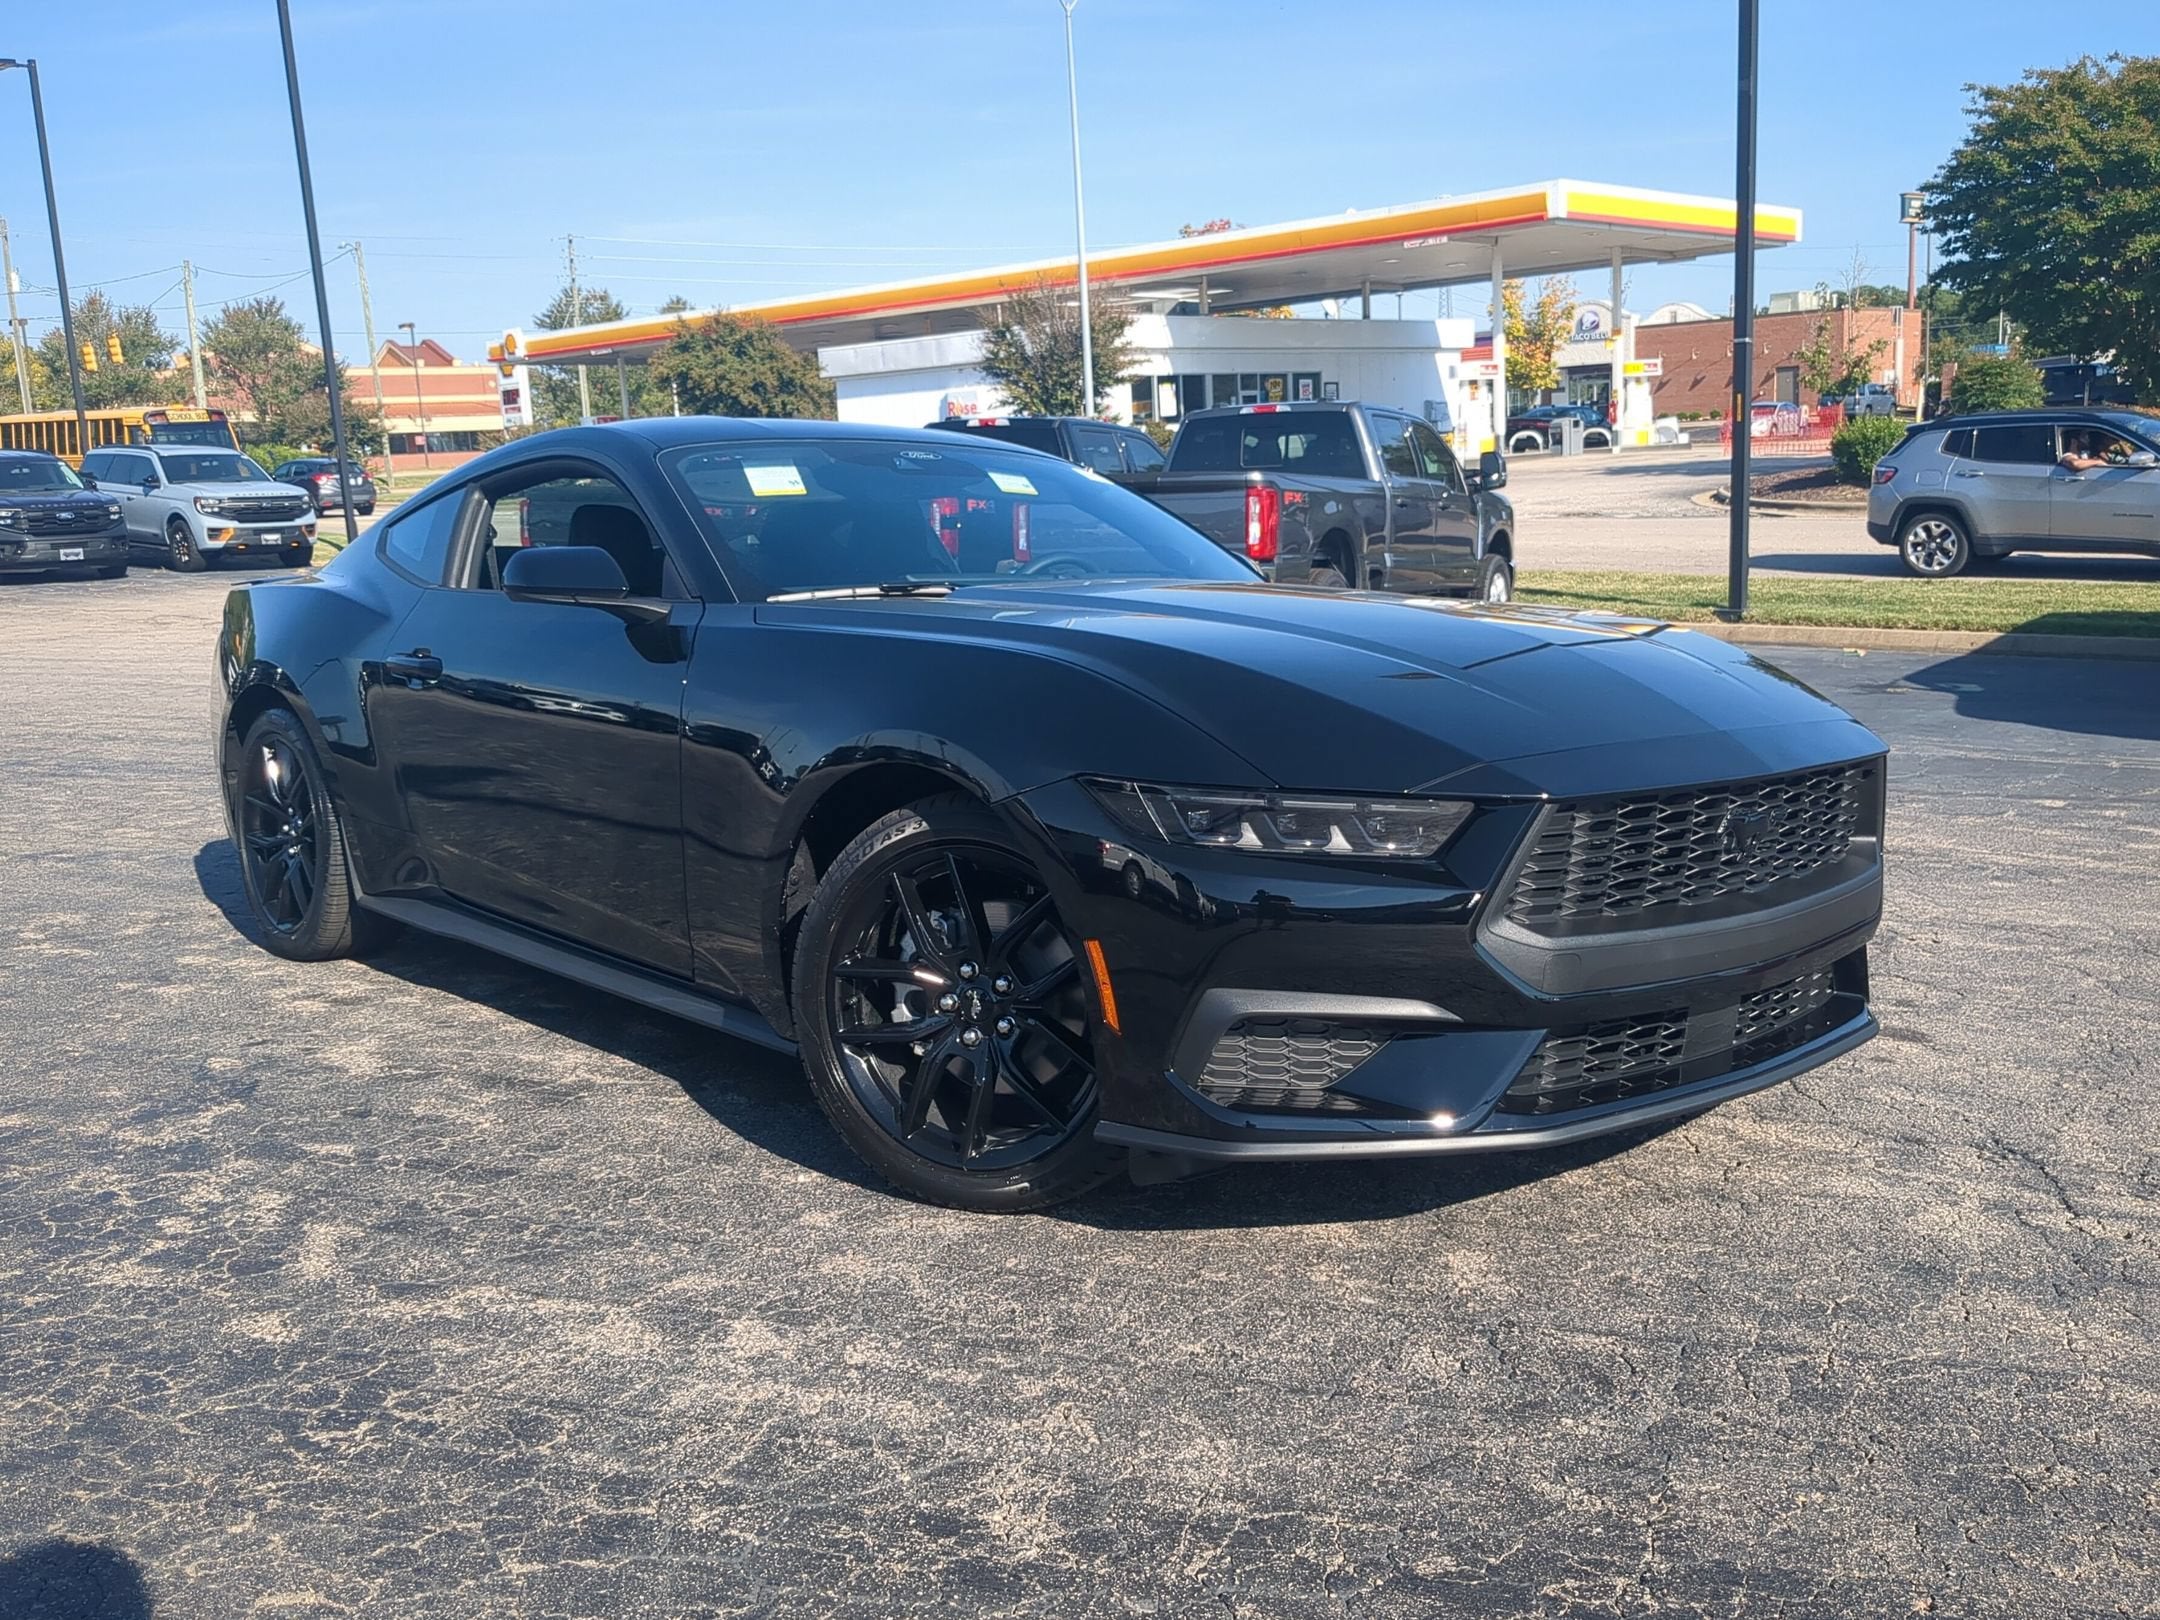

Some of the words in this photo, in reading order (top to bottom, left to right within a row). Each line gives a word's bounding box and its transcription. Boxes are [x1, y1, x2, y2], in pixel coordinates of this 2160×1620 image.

[947, 402, 977, 417] Rose
[880, 825, 907, 846] AS
[912, 820, 924, 831] 3
